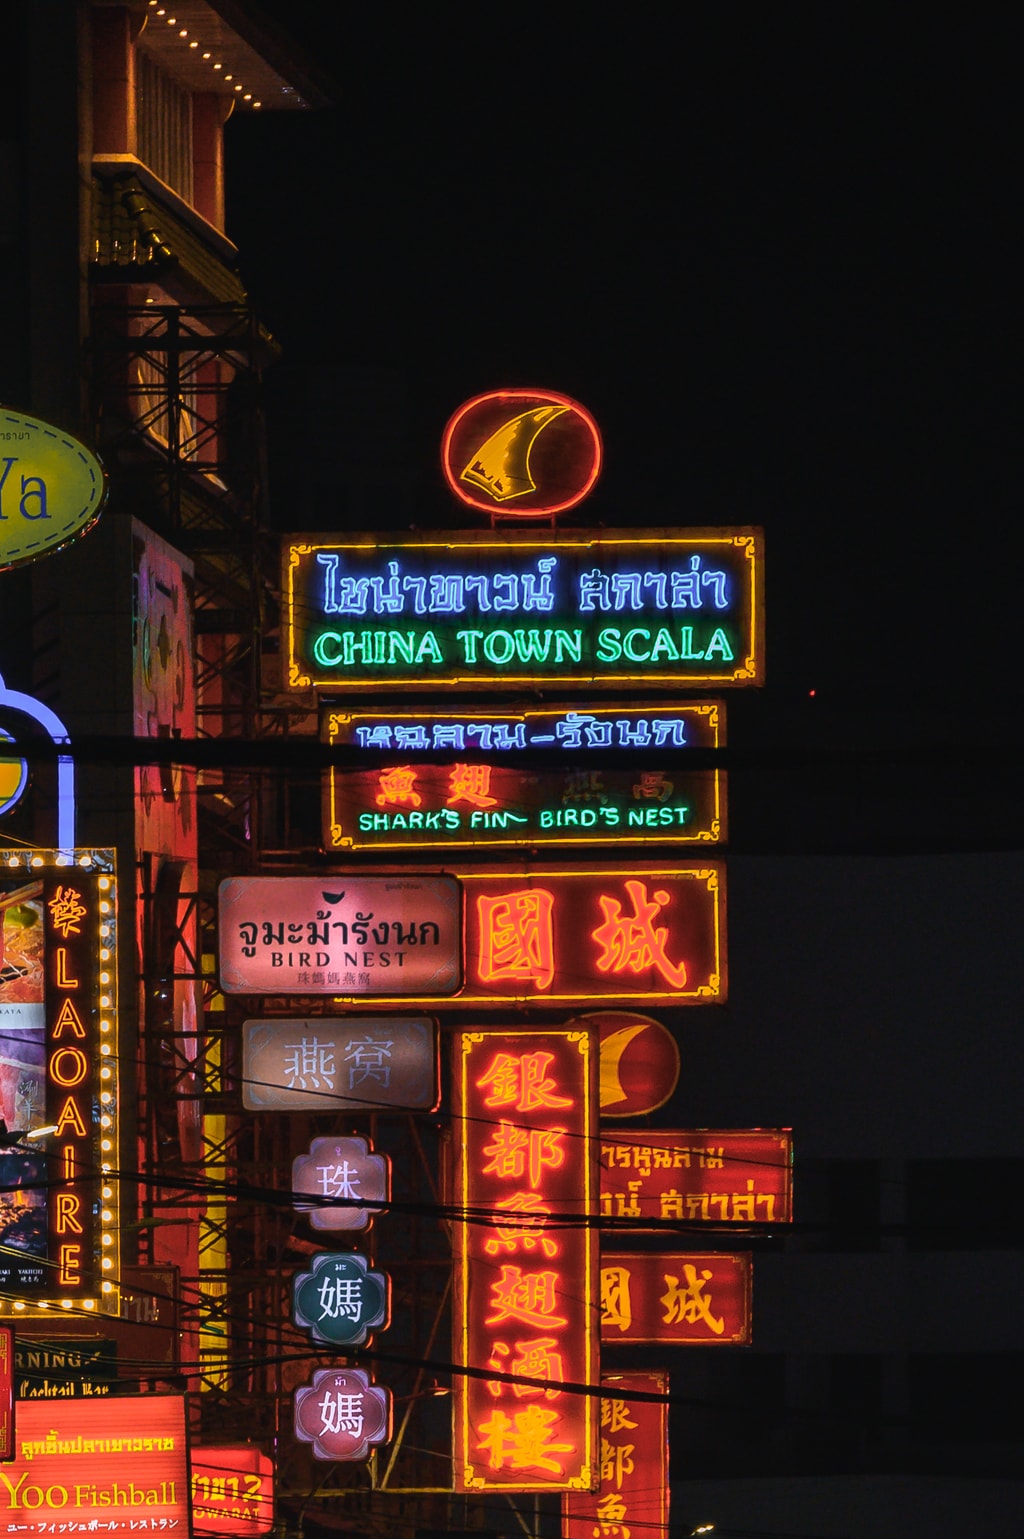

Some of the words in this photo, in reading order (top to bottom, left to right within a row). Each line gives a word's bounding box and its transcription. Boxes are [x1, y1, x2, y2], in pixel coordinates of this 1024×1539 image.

[316, 553, 558, 614] ไชน่าทาวน์
[578, 554, 729, 611] สกาล่า
[313, 630, 443, 665] CHINA
[456, 628, 583, 664] TOWN
[596, 625, 734, 663] SCALA
[359, 808, 461, 831] SHARK'S
[539, 808, 620, 829] BIRD'S
[628, 807, 689, 826] NEST
[238, 911, 441, 958] จูมะม้ารังนก
[272, 952, 331, 967] BIRD
[344, 951, 407, 967] NEST
[284, 1036, 394, 1090] 燕窝
[316, 1160, 362, 1201] 珠
[317, 1276, 364, 1324] 媽
[318, 1391, 365, 1440] 媽
[21, 1429, 175, 1460] ลูกชิ้นปลาเยาวราช
[0, 1471, 69, 1510] Yoo
[73, 1482, 178, 1508] Fishball
